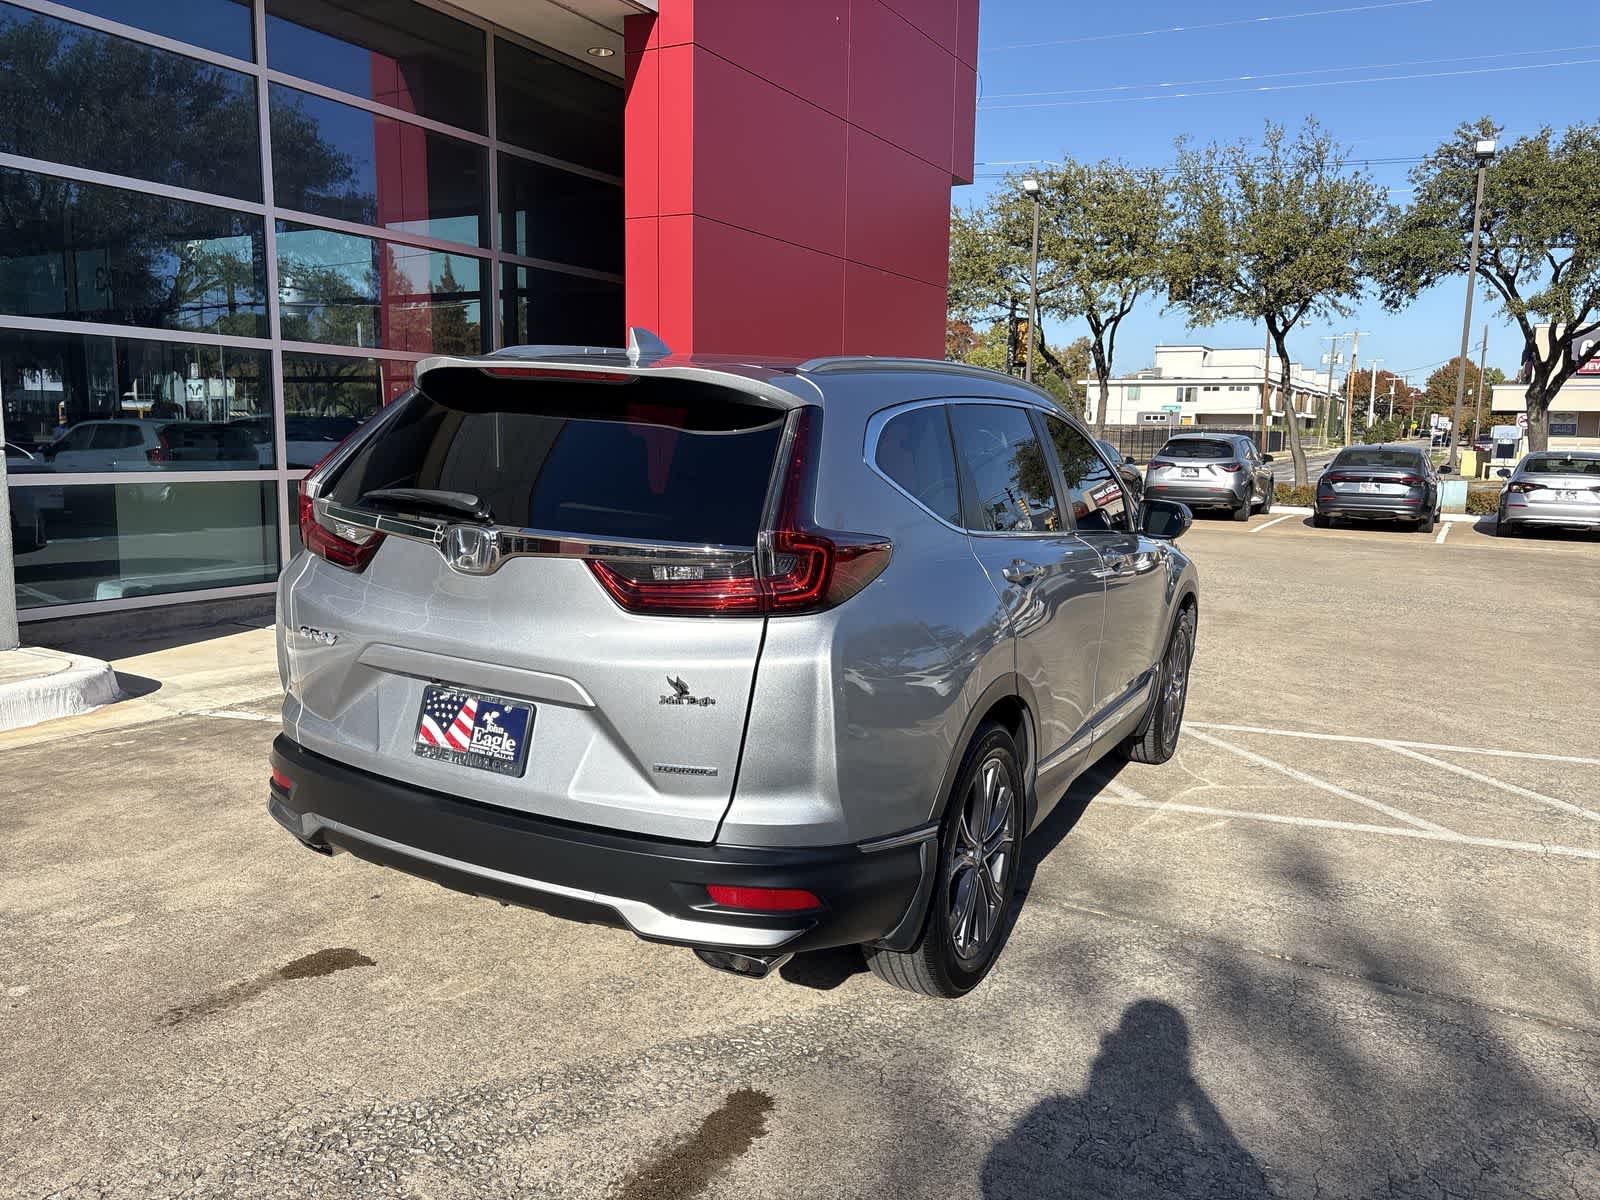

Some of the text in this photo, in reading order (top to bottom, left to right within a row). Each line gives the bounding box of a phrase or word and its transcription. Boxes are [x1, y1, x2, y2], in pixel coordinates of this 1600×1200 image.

[486, 723, 504, 735] John
[472, 726, 517, 753] Eagle
[493, 752, 514, 761] DALLAS
